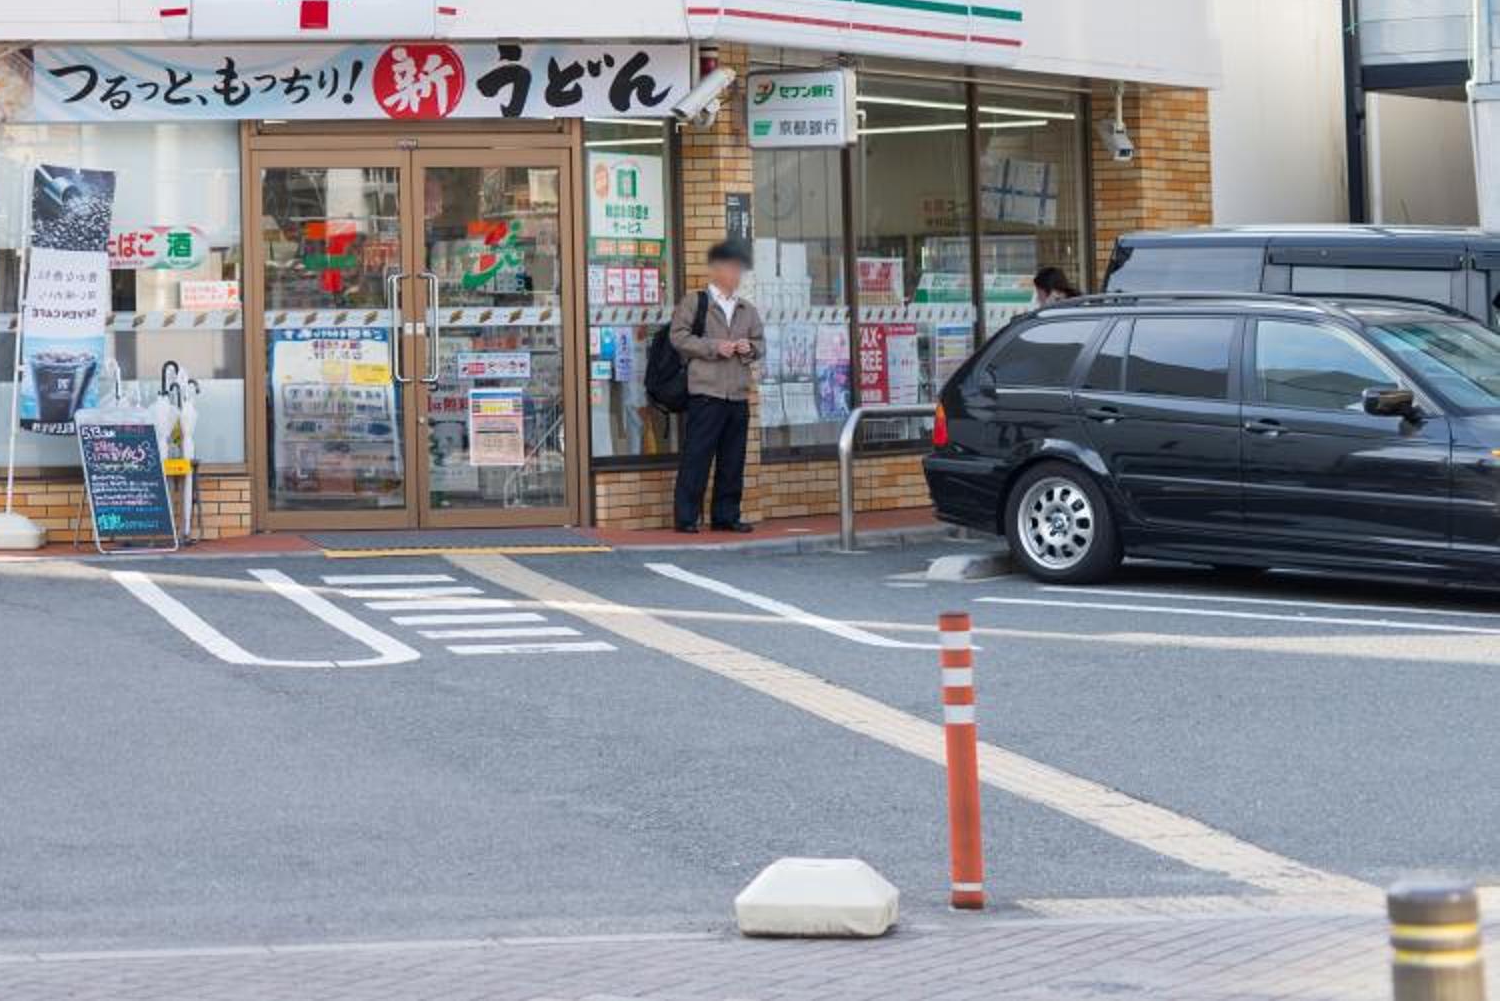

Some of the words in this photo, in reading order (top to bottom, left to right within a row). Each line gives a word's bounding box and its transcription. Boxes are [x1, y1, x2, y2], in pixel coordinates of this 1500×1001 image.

[476, 44, 674, 118] うどん
[779, 119, 837, 136] 京都銀行
[166, 232, 192, 258] 酒
